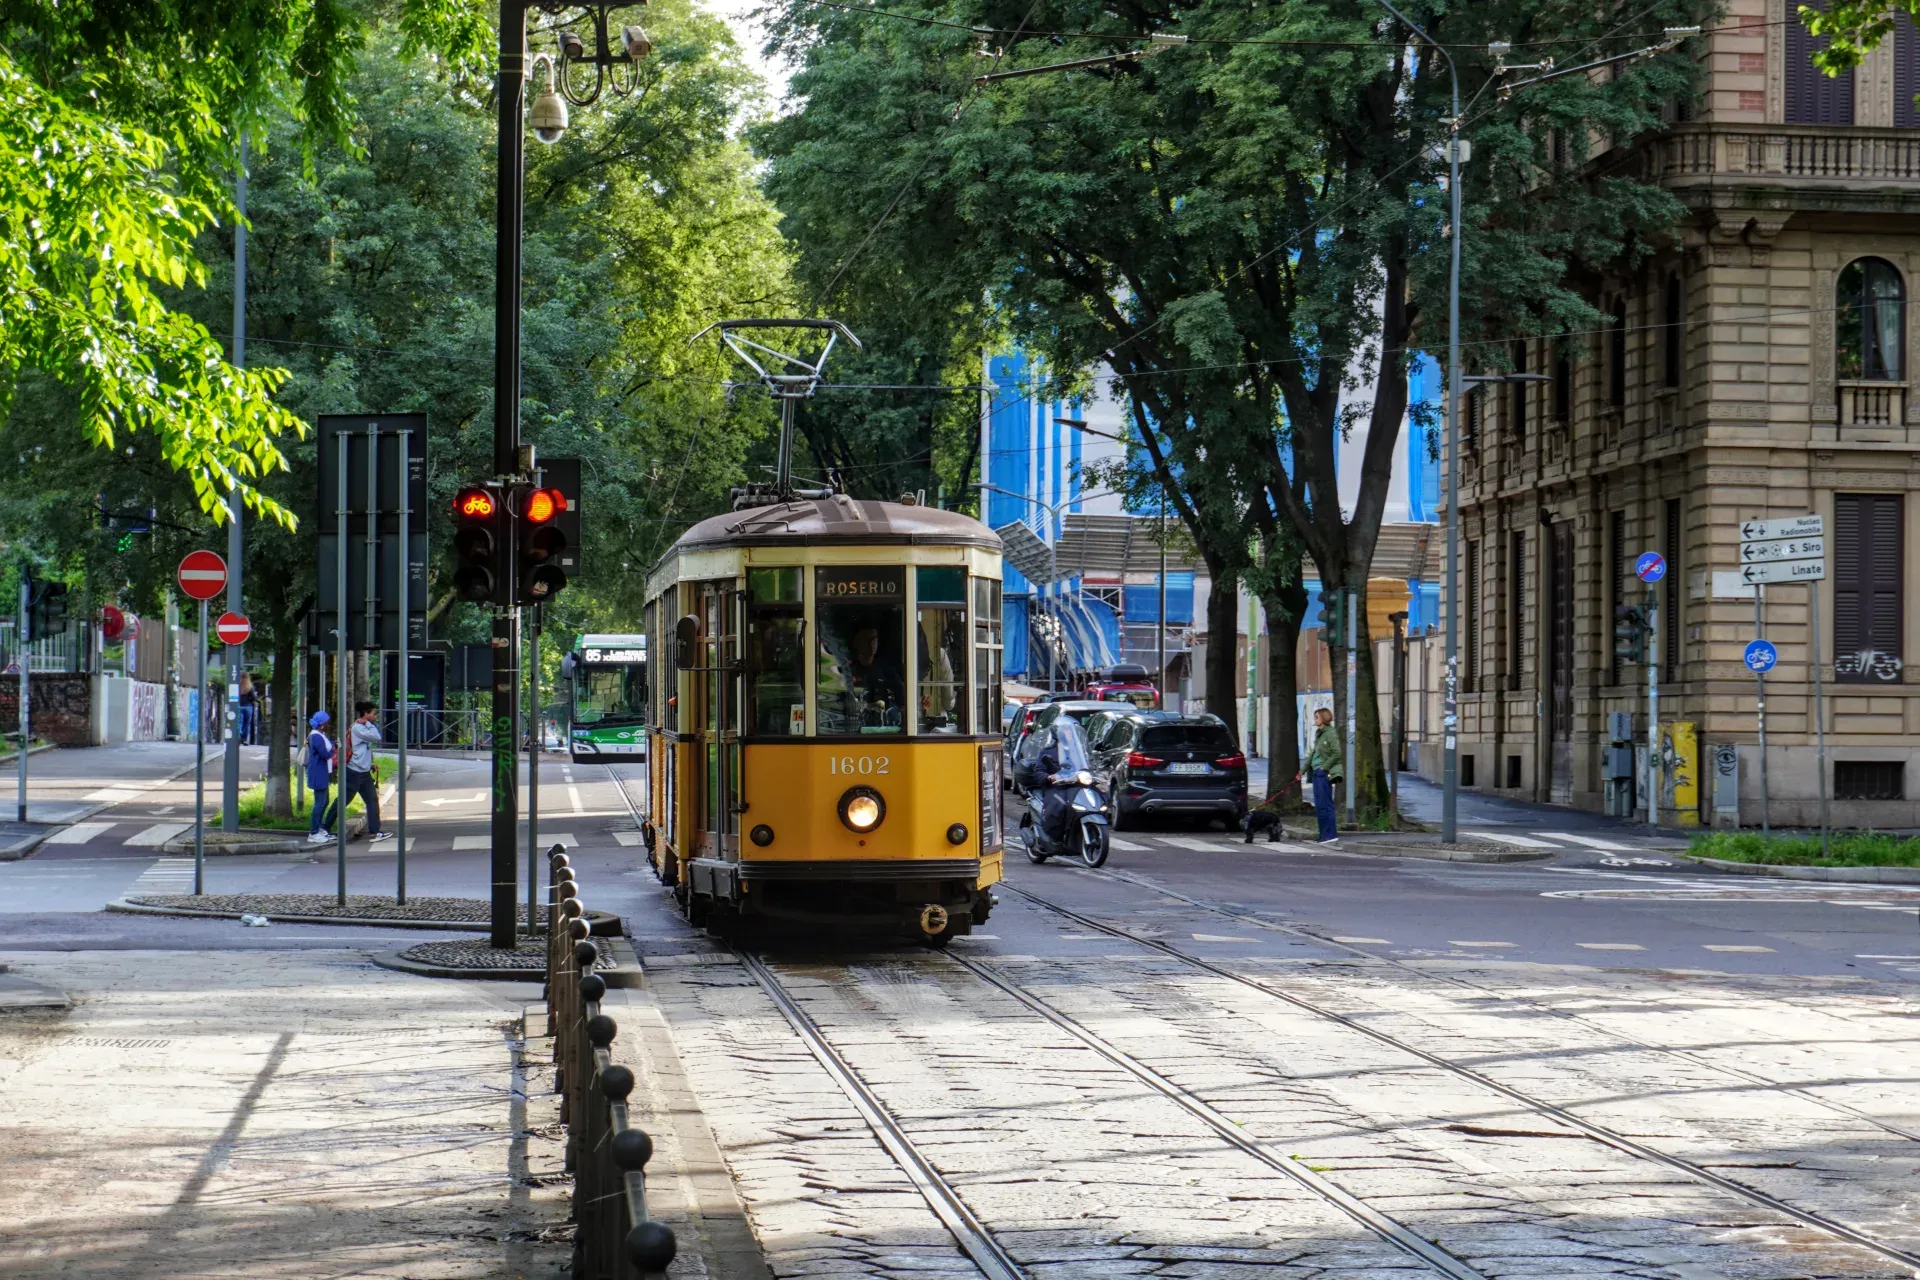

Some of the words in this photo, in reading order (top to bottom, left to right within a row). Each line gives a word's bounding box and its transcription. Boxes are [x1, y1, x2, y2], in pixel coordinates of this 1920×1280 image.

[1789, 544, 1798, 553] S.
[1802, 543, 1821, 552] Siro
[1792, 565, 1822, 575] Linate
[826, 581, 896, 594] ROSERIO
[585, 649, 601, 662] 85
[830, 756, 890, 775] 1602
